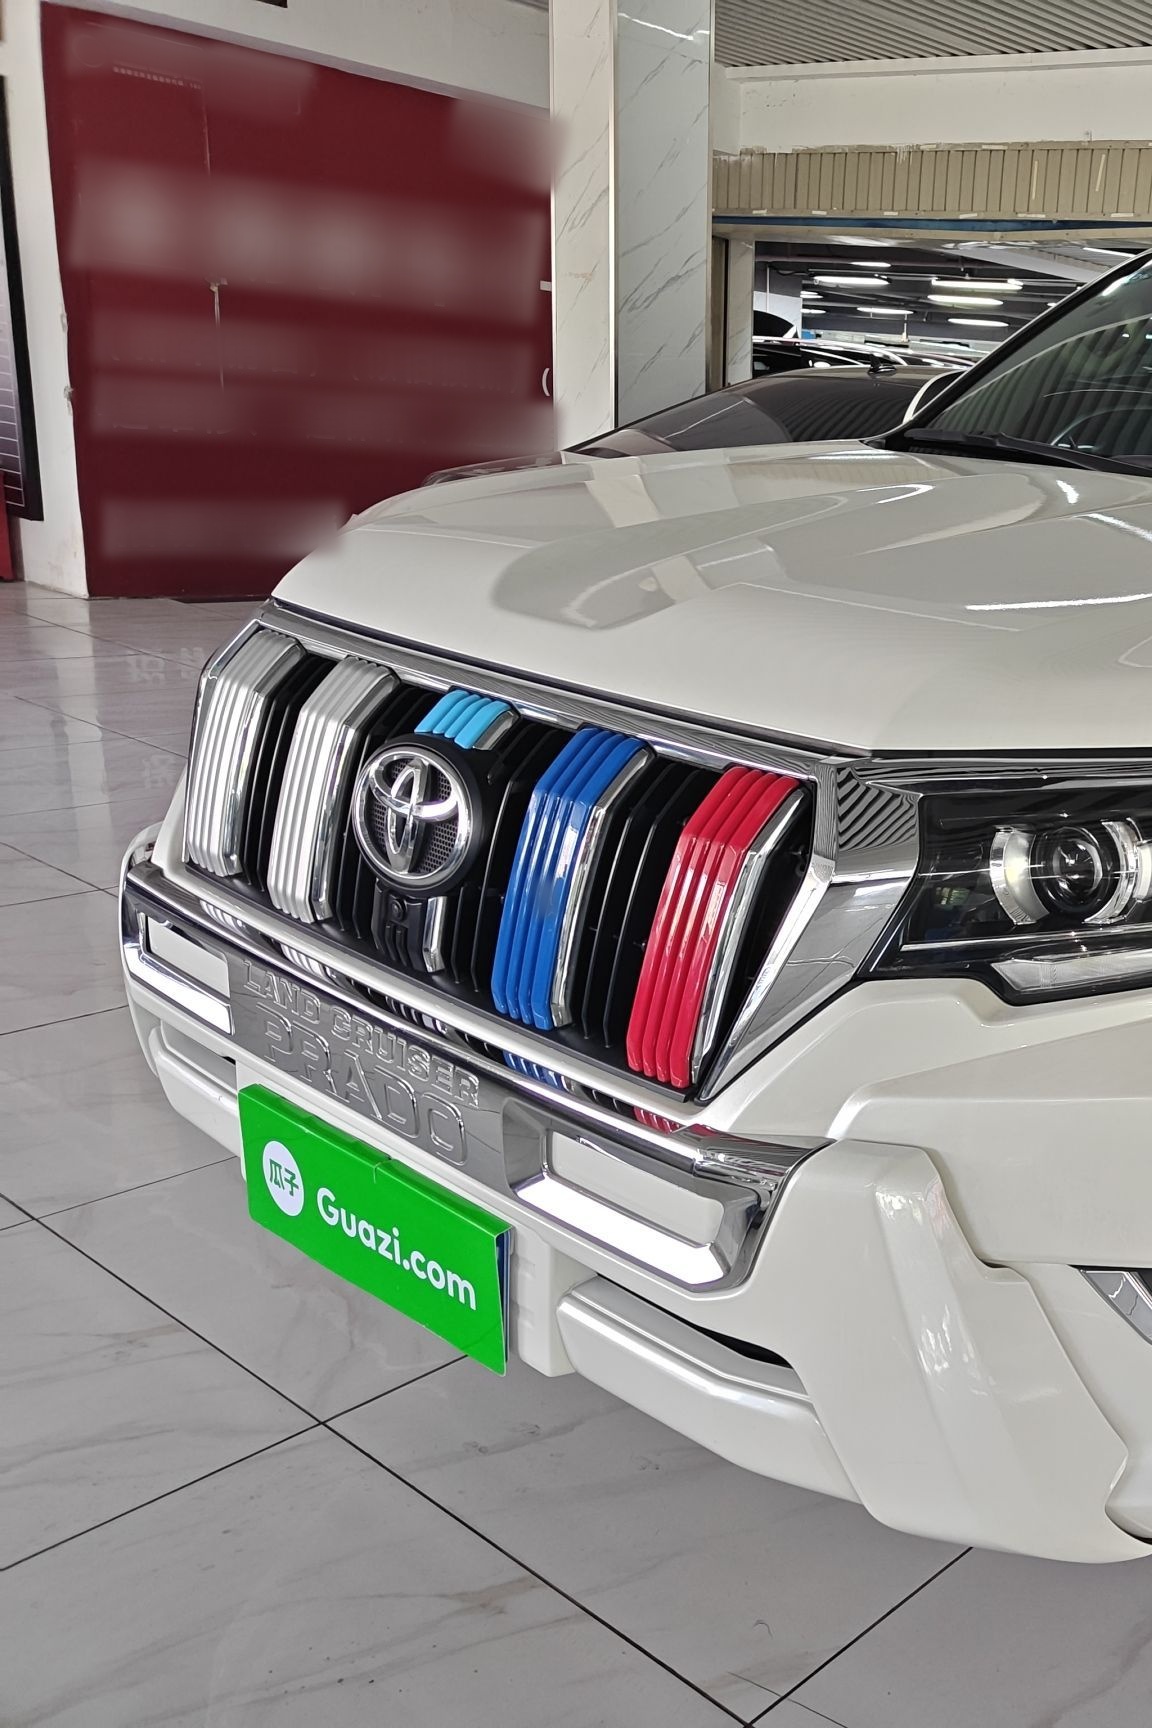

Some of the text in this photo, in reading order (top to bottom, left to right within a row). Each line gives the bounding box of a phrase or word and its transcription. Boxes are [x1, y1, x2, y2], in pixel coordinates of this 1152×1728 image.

[243, 960, 480, 1109] LAND CRUISER
[255, 1002, 467, 1166] PRADO
[269, 1158, 299, 1197] 瓜子
[317, 1187, 476, 1311] Guazi.com
